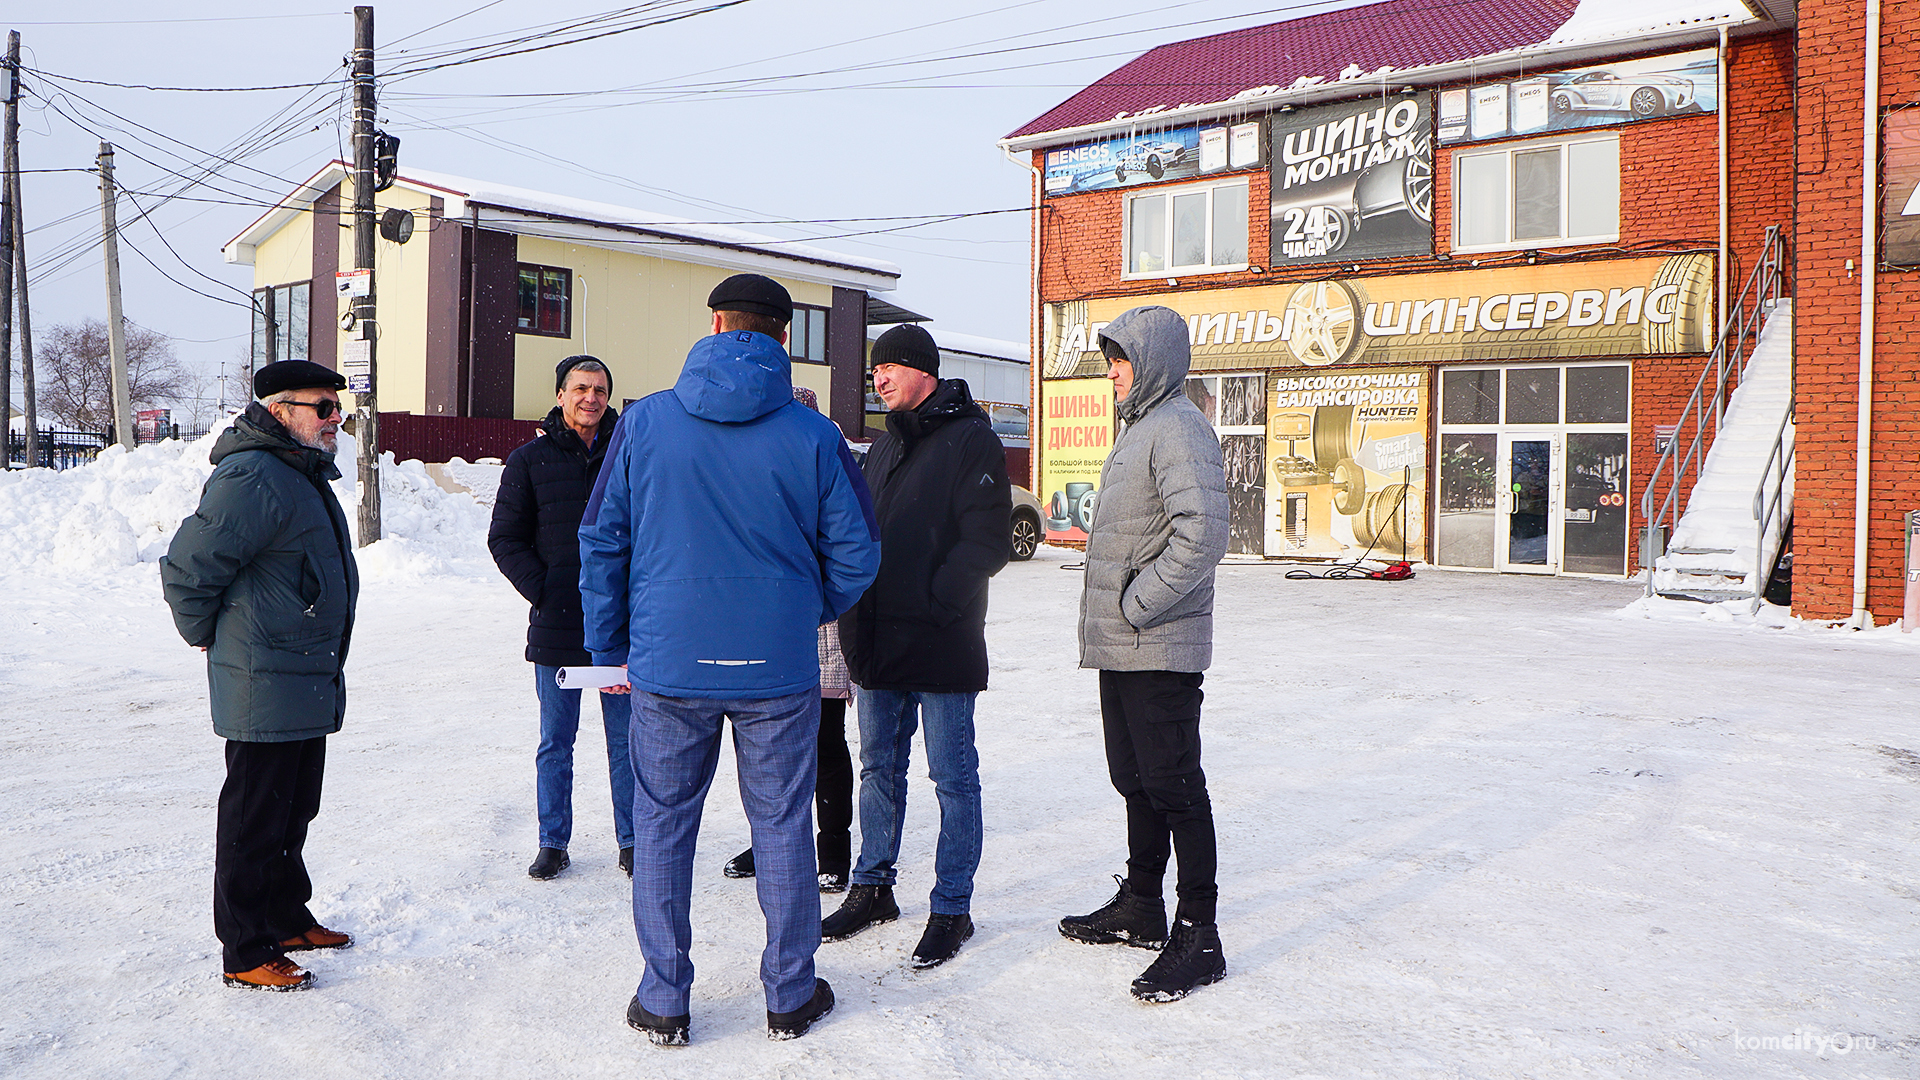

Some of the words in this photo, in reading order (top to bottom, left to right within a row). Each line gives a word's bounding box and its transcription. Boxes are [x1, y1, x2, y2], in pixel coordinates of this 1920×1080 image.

[1480, 95, 1499, 104] ENEOS
[1520, 88, 1541, 97] ENEOS
[1283, 100, 1418, 164] ШИНО
[1060, 143, 1110, 164] ENEOS
[1283, 131, 1418, 189] МОНТАЖ
[1125, 162, 1147, 171] ENEOS
[1283, 206, 1327, 241] 24
[1283, 240, 1327, 258] ЧАСА
[1363, 284, 1680, 336] ШИНСЕРВИС
[1276, 373, 1422, 392] ВЫСОКОТОЧНАЯ
[1049, 394, 1107, 418] ШИНЫ
[1277, 389, 1420, 408] БАЛАНСИРОВКА
[1358, 407, 1418, 416] HUNTER
[1048, 426, 1107, 450] ДИСКИ
[1375, 436, 1411, 457] Smart
